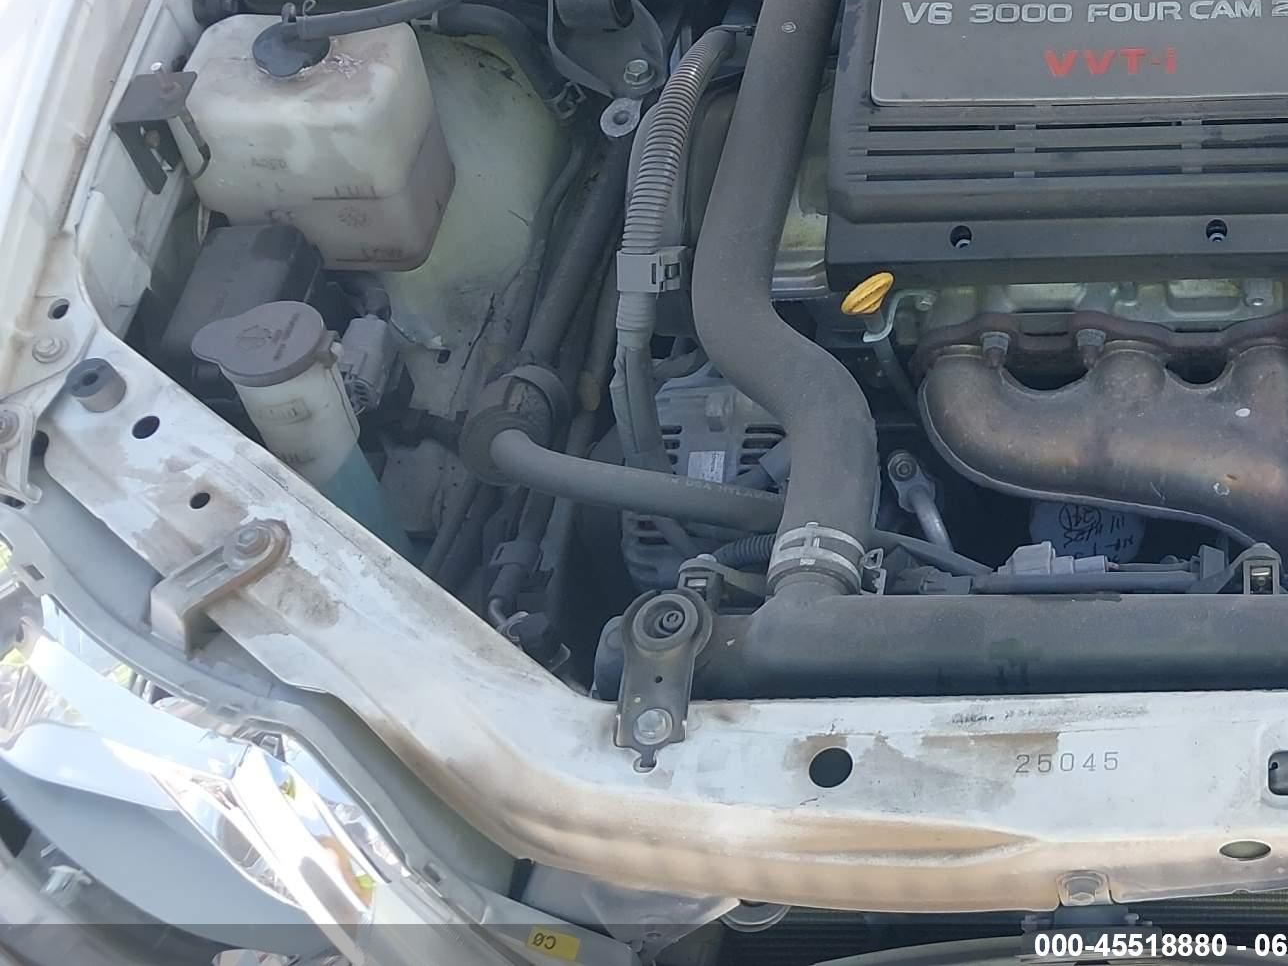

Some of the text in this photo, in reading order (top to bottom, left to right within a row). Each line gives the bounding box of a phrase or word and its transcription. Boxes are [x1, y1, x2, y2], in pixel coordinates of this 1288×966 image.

[901, 1, 953, 26] V6
[969, 2, 1073, 25] 3000
[1087, 0, 1182, 23] FOUR
[1044, 47, 1178, 78] VVT-i
[1014, 751, 1121, 775] 25045
